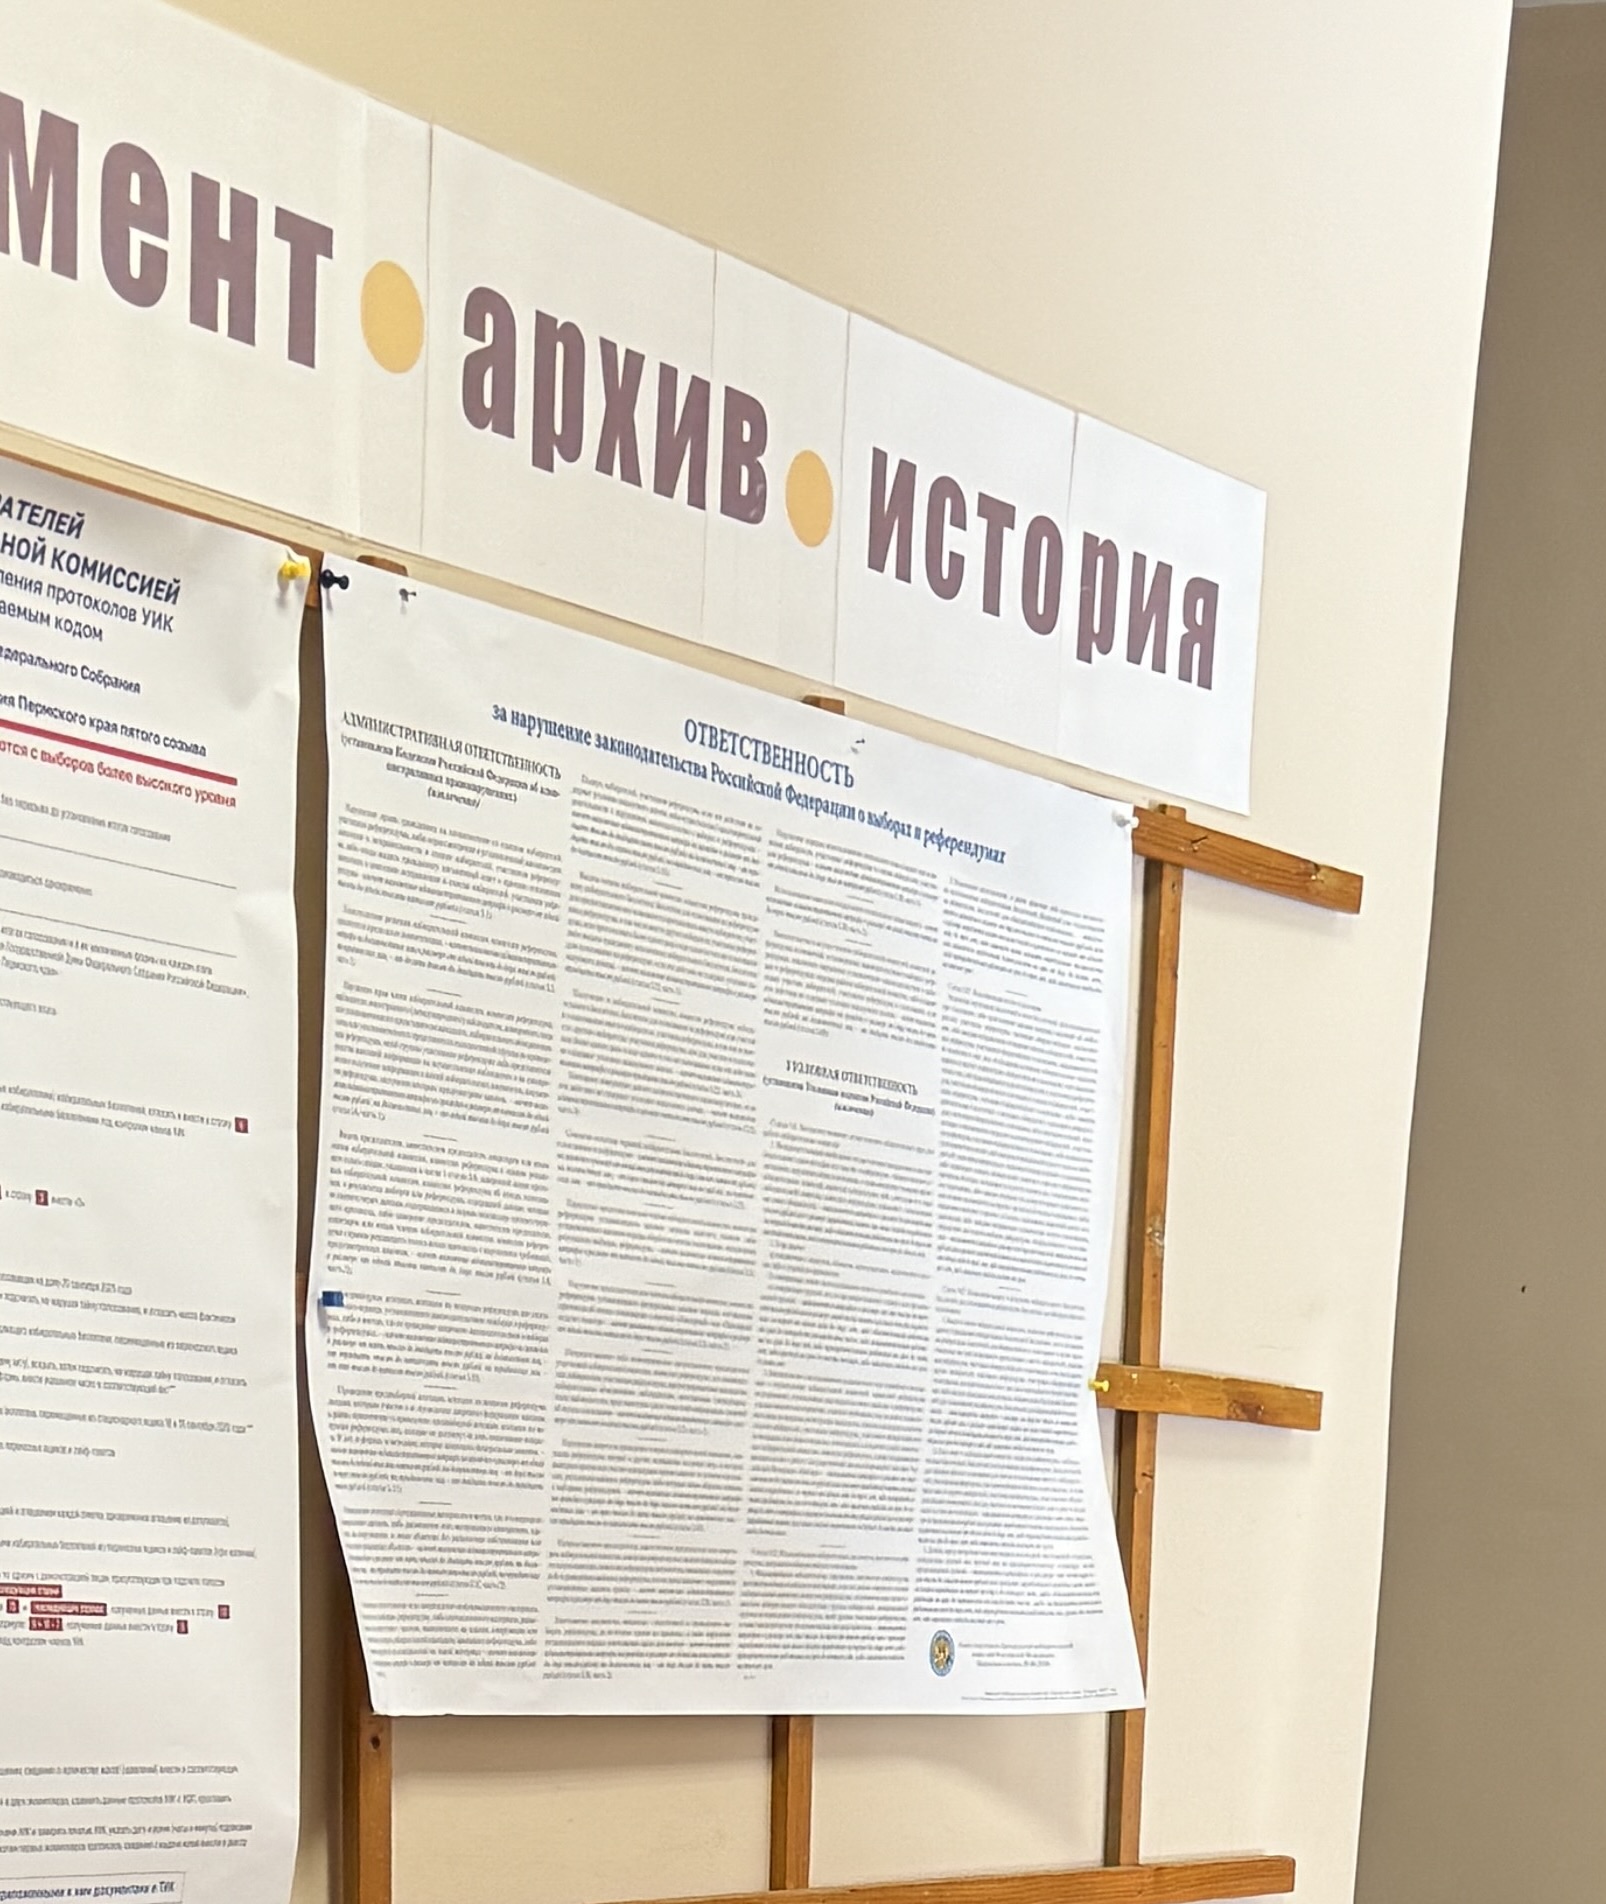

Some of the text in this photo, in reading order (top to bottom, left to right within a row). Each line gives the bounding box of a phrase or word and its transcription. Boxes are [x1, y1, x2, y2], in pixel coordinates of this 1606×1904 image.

[0, 92, 1221, 691] мент архив история
[0, 494, 85, 539] АТЕЛЕЙ
[1, 532, 181, 605] НОЙ КОМИССИЕЙ
[47, 583, 137, 622] протоколов
[142, 607, 174, 632] УИК
[55, 616, 103, 641] кодом
[81, 665, 140, 694] Собрания
[18, 695, 86, 726] Пермского
[89, 716, 118, 735] края
[121, 724, 160, 745] пятого
[163, 733, 206, 757] созыва
[342, 711, 561, 780] АДМИНИСТРАТИВНАЯ ОТВЕТСТВЕННОСТЬ
[684, 718, 854, 787] ОТВЕТСТВЕННОСТЬ
[31, 748, 38, 759] с
[40, 750, 94, 774] выборов
[97, 762, 133, 783] более
[136, 772, 191, 798] высокого
[195, 787, 236, 808] уровня
[491, 704, 1006, 863] за нарушение законодательства Российской Федерации о выборах и референдумах
